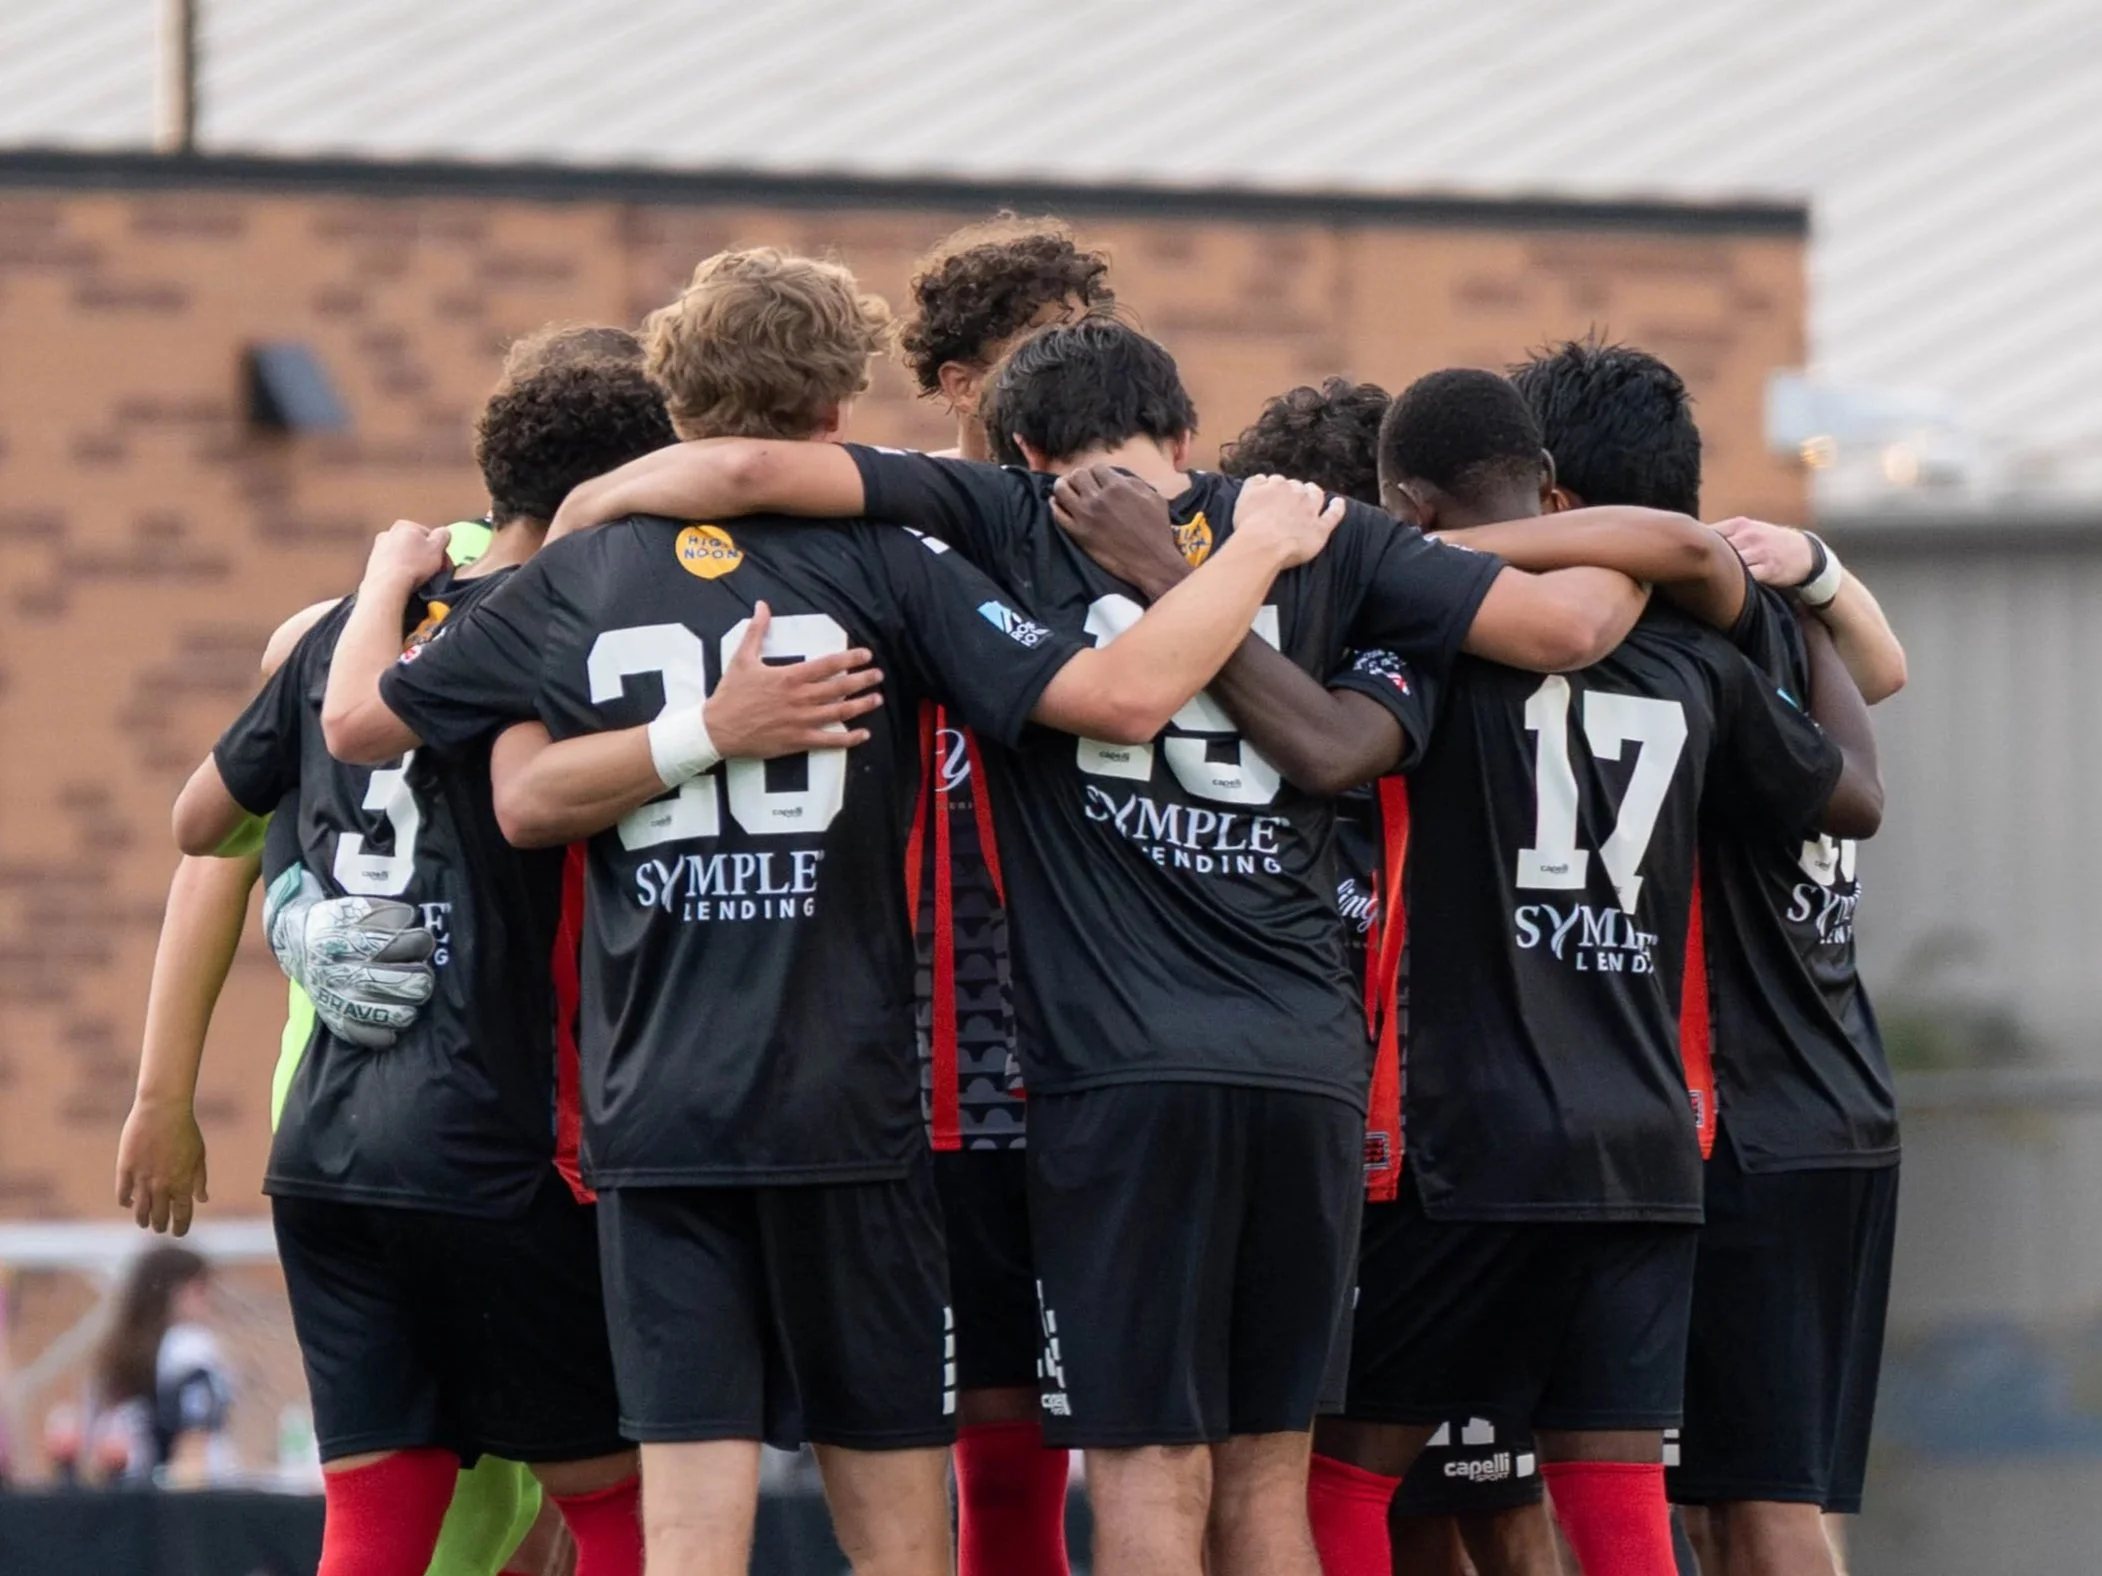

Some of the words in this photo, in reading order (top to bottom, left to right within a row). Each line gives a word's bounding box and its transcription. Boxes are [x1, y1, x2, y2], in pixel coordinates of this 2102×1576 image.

[684, 548, 739, 560] NOON
[688, 535, 728, 548] HIG
[1515, 674, 1688, 915] 17
[1142, 846, 1282, 875] ENDING
[635, 850, 819, 913] SYMPLE
[683, 898, 815, 922] LENDING
[317, 986, 390, 1023] BRAVO
[1443, 1452, 1511, 1481] capelli
